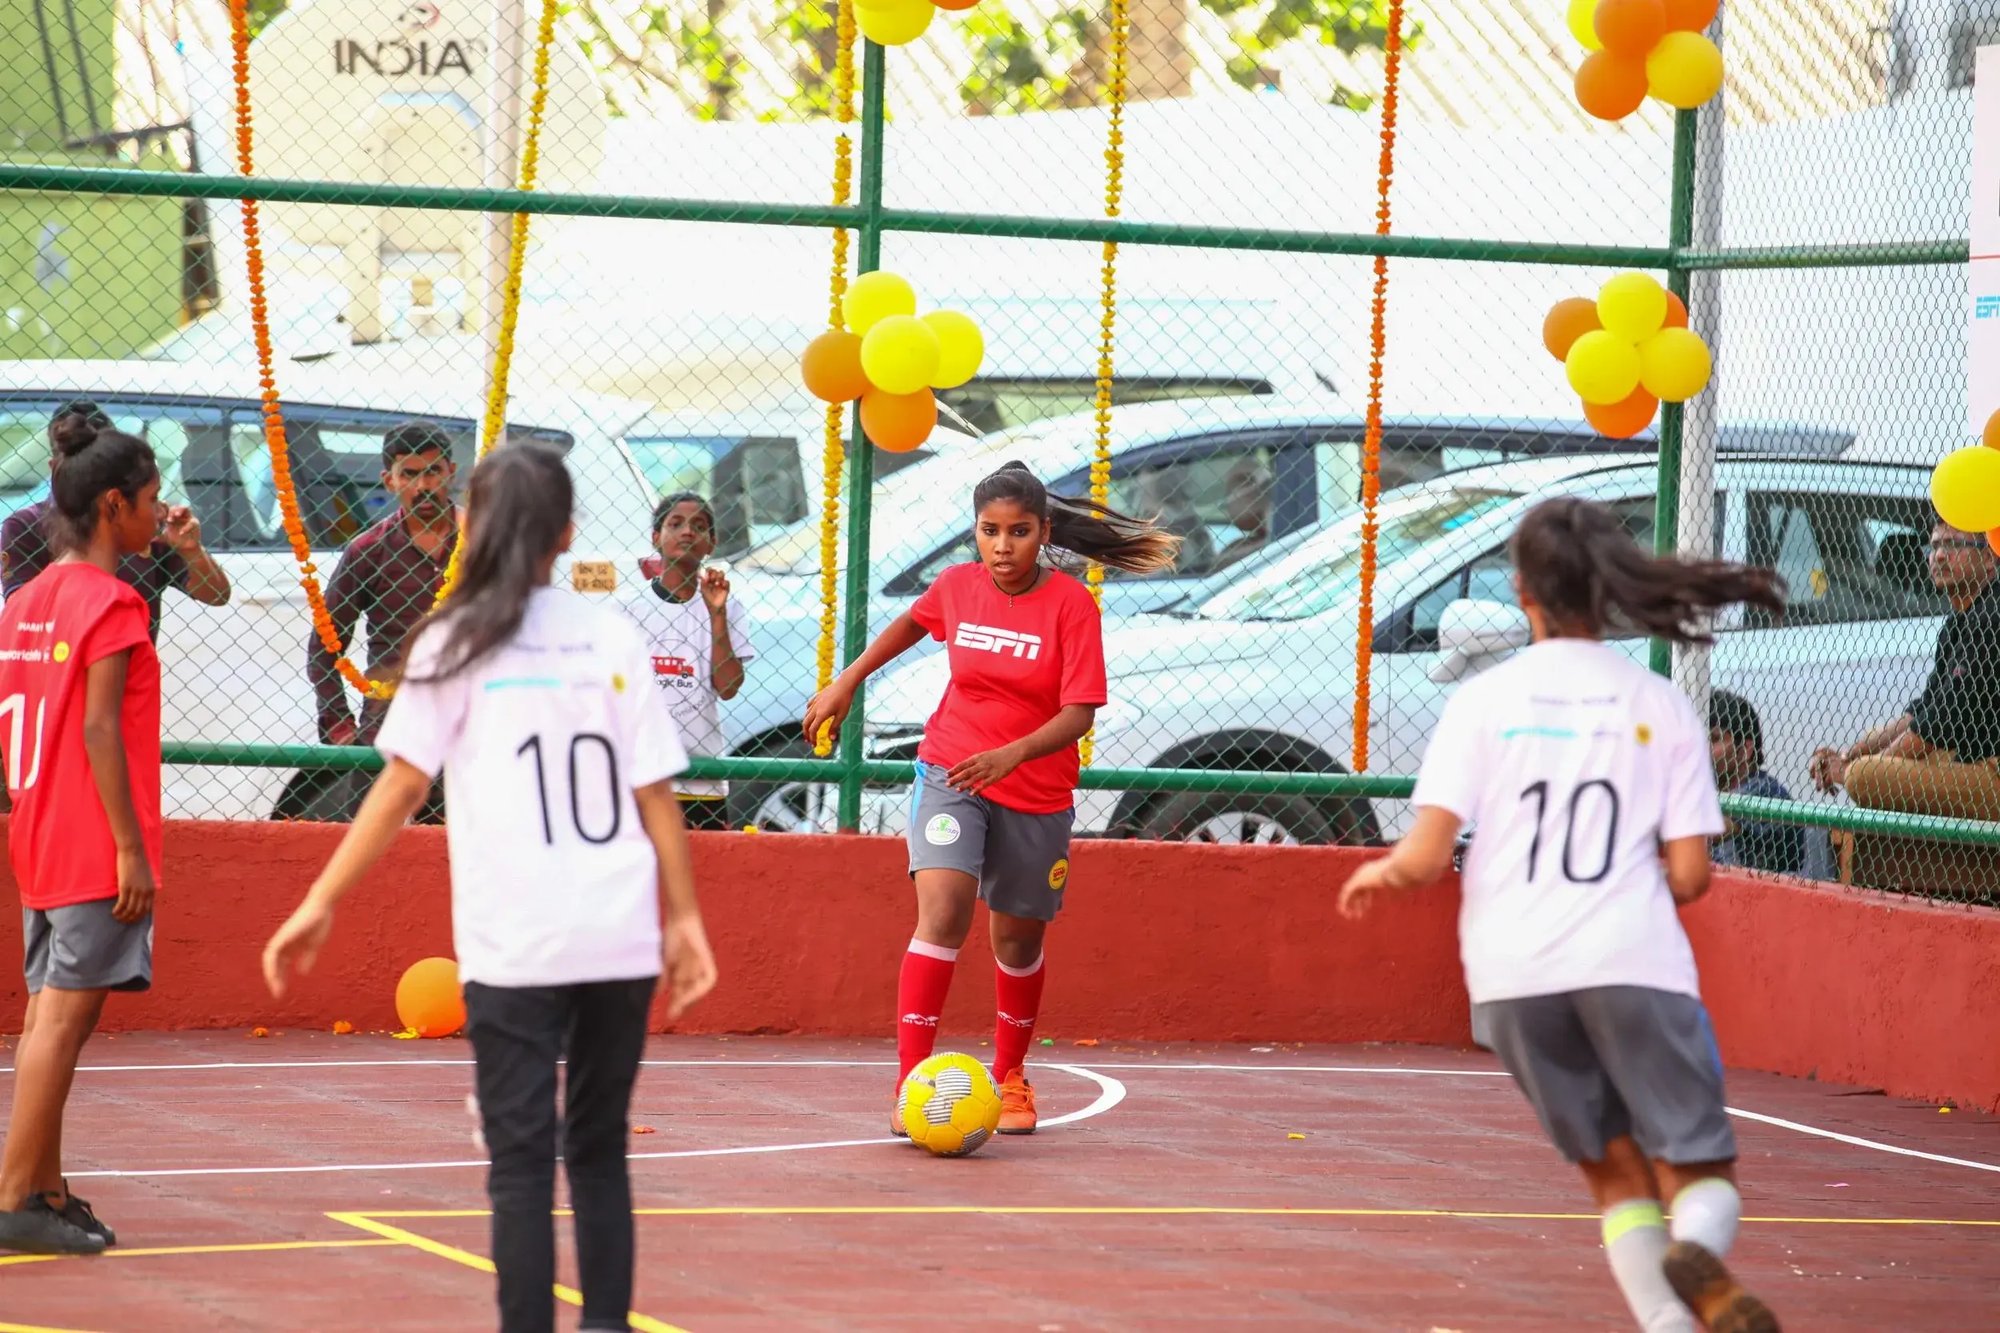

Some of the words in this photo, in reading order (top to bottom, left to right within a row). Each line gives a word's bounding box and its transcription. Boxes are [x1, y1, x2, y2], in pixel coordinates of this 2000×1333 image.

[1976, 296, 2000, 319] ESP
[954, 622, 1042, 660] ESPN
[677, 680, 693, 688] Bus
[517, 734, 620, 844] 10
[1520, 780, 1619, 883] 10
